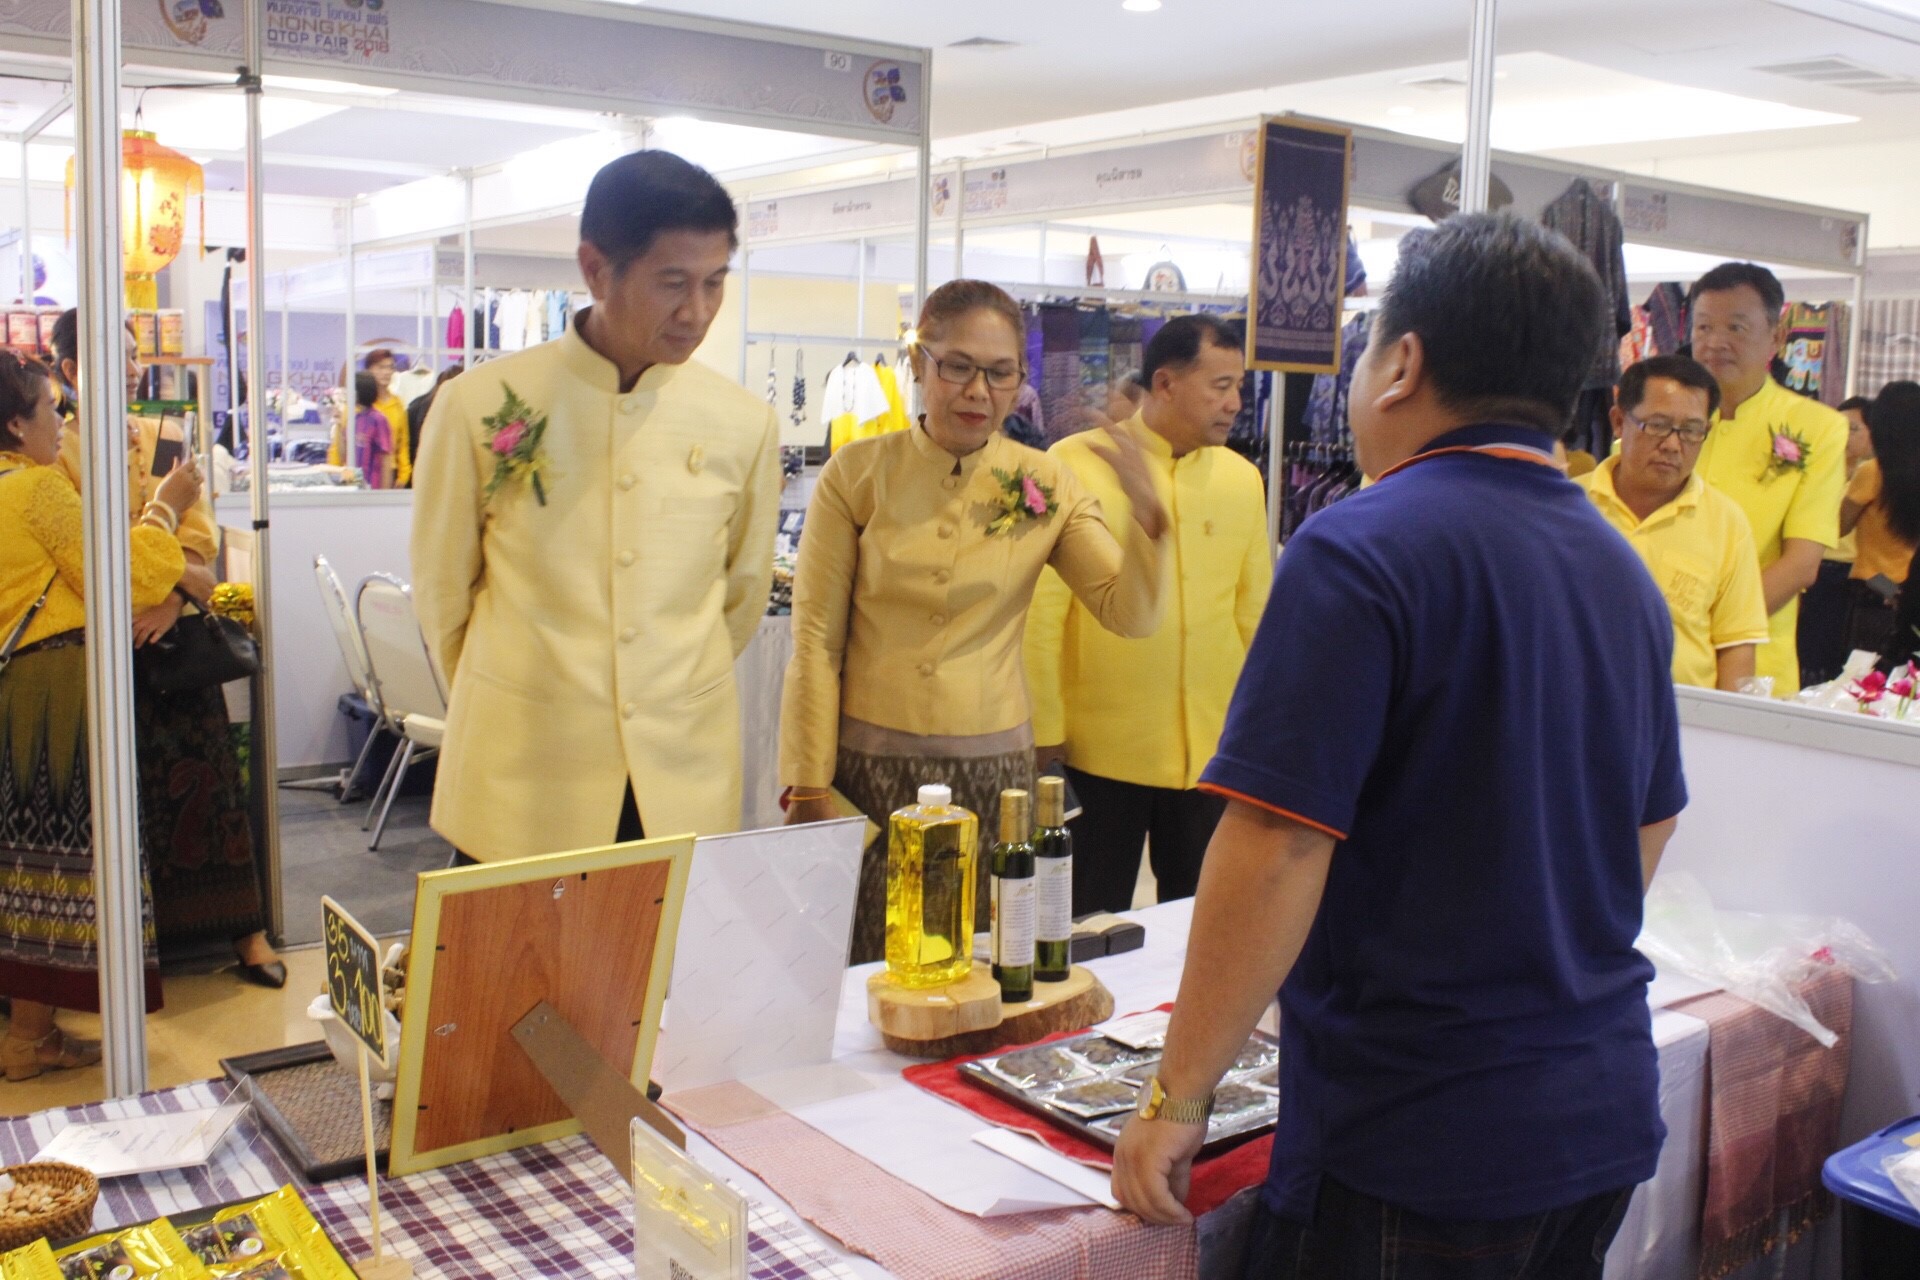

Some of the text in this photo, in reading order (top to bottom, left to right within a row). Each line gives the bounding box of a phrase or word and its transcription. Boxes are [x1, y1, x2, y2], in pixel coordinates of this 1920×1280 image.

[268, 14, 389, 40] NONG KHAI
[267, 29, 309, 43] OTOP
[315, 34, 348, 49] FAIR
[354, 38, 389, 54] 2018
[830, 54, 846, 69] 90
